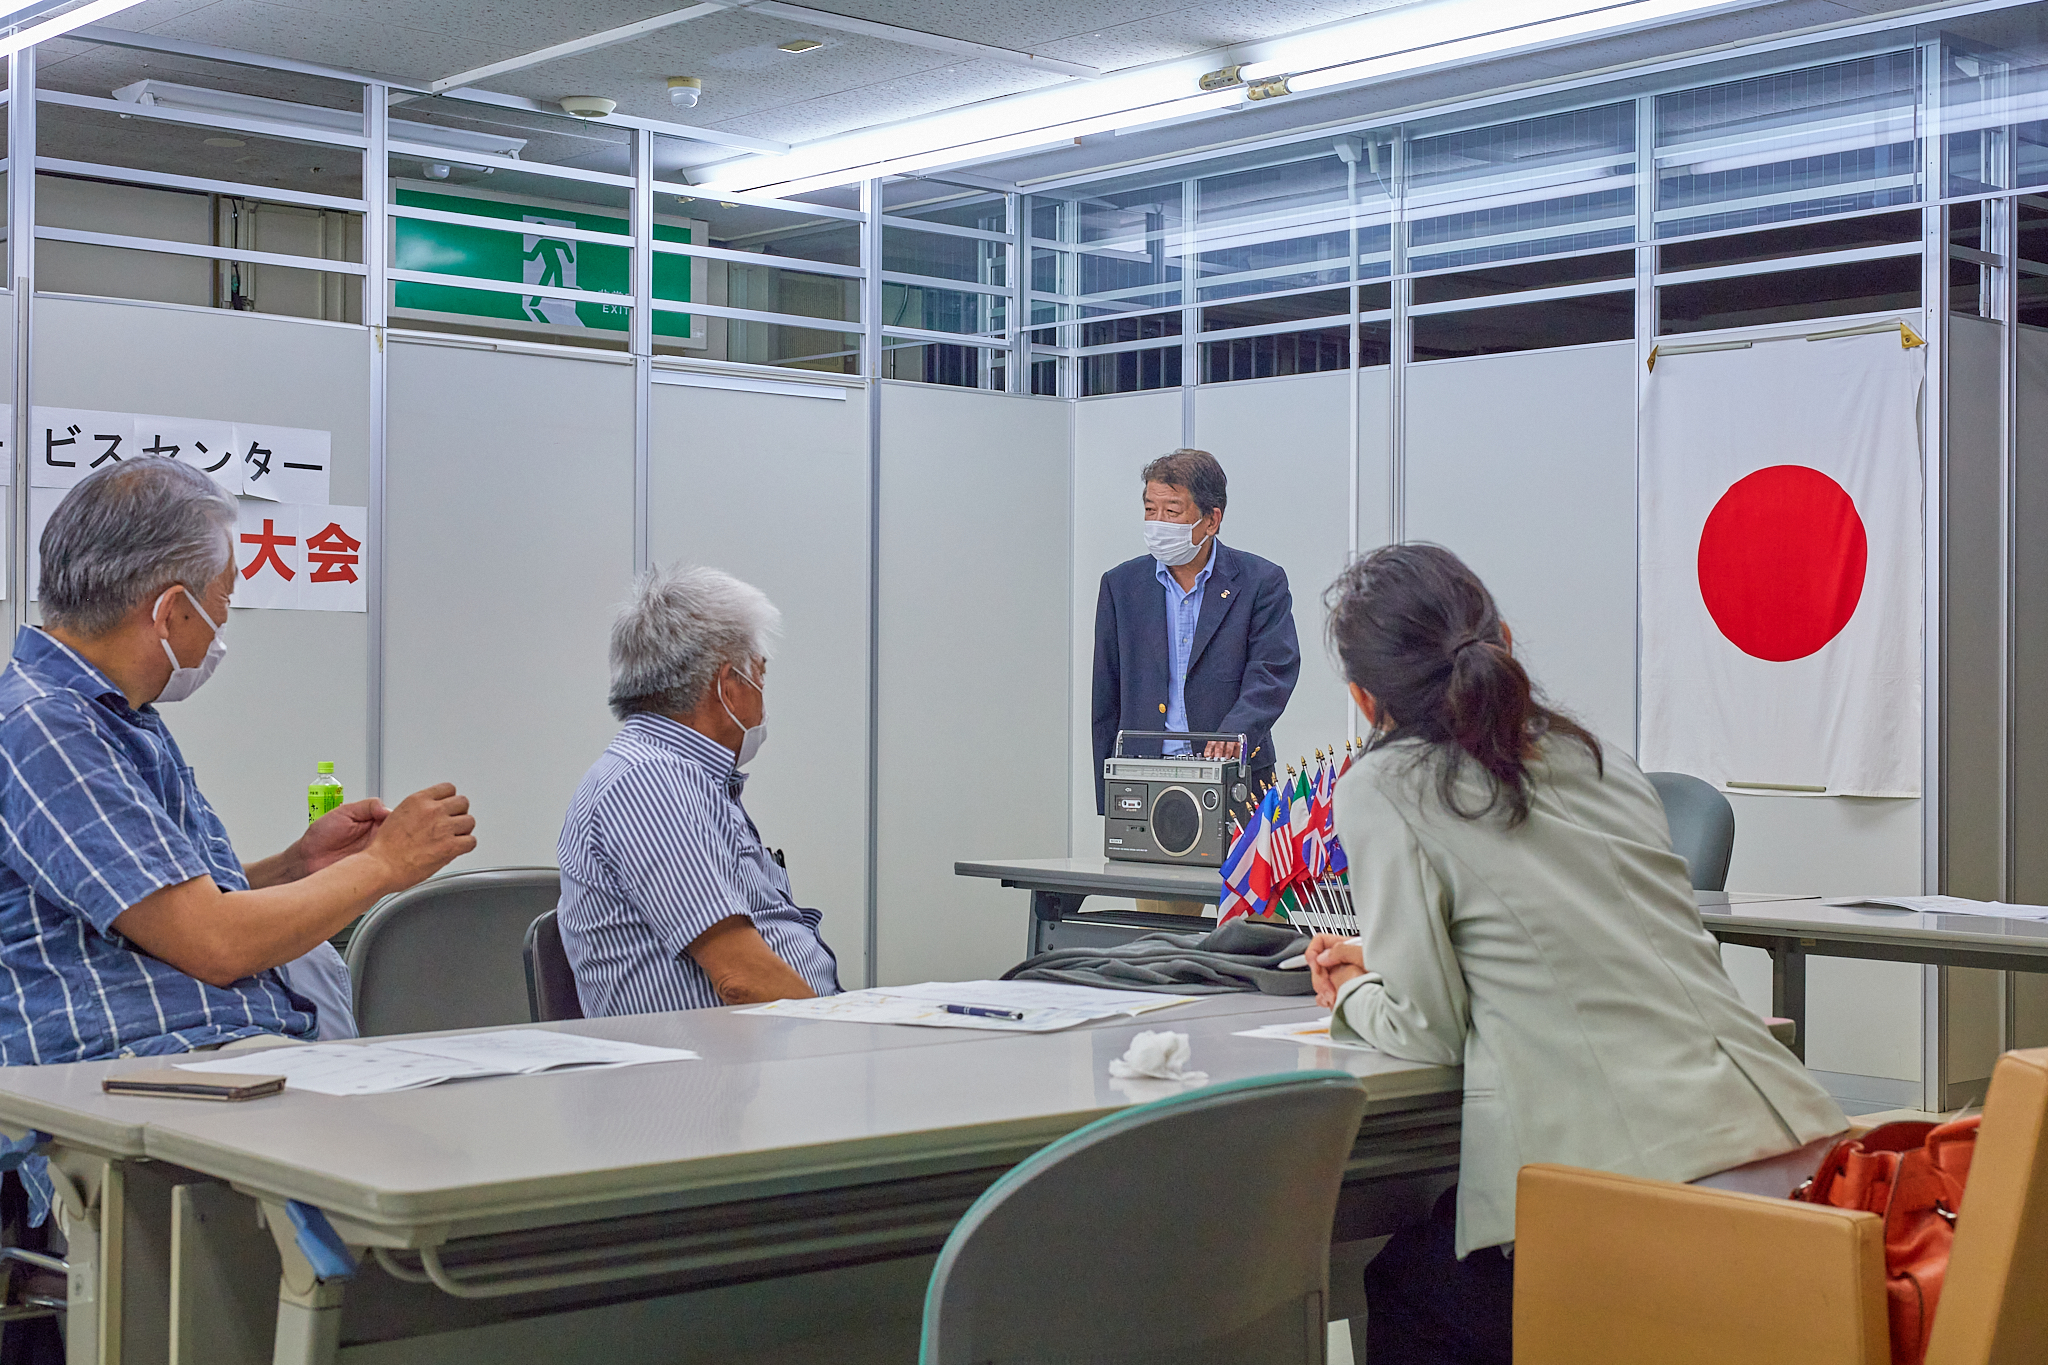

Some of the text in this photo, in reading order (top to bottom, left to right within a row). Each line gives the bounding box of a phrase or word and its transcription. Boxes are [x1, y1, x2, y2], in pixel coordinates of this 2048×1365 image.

[602, 304, 629, 316] EXIT
[0, 424, 323, 482] ビスセンター
[240, 518, 361, 584] 大会
